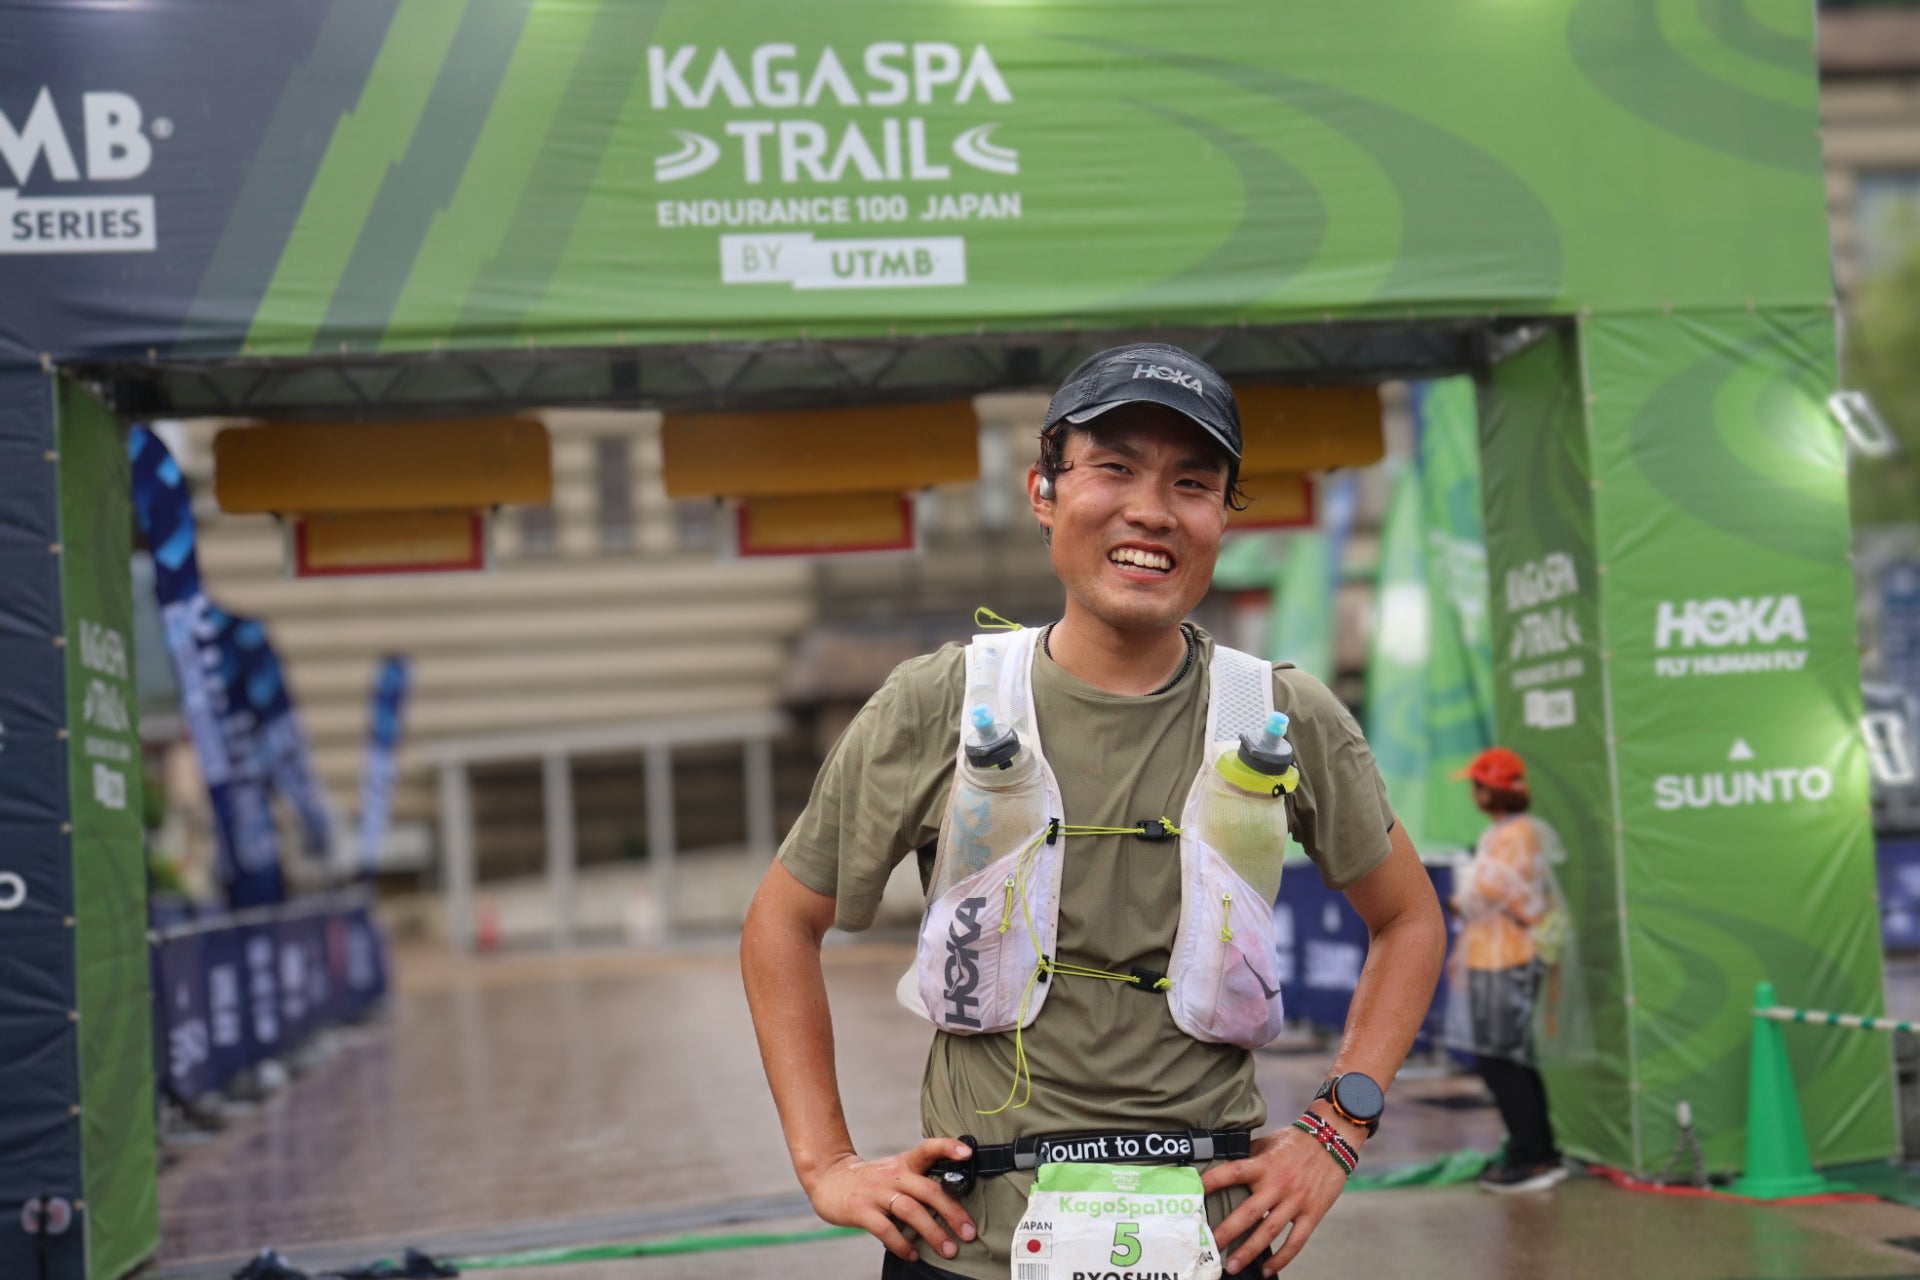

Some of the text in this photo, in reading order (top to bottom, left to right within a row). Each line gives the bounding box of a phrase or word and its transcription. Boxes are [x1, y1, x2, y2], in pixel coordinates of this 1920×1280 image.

[725, 118, 950, 183] TRAIL
[11, 209, 142, 241] SERIES
[657, 193, 1022, 227] ENDURANCE 100 JAPAN
[742, 243, 783, 273] BY
[1132, 364, 1203, 397] HOKA
[1655, 595, 1807, 648] HOKA
[1654, 766, 1832, 810] SUUNTO
[943, 896, 987, 1029] HOKA
[1115, 1137, 1139, 1156] to
[1059, 1196, 1193, 1219] KagaSpa100
[1020, 1222, 1053, 1234] JAPAN
[1110, 1222, 1142, 1268] 5
